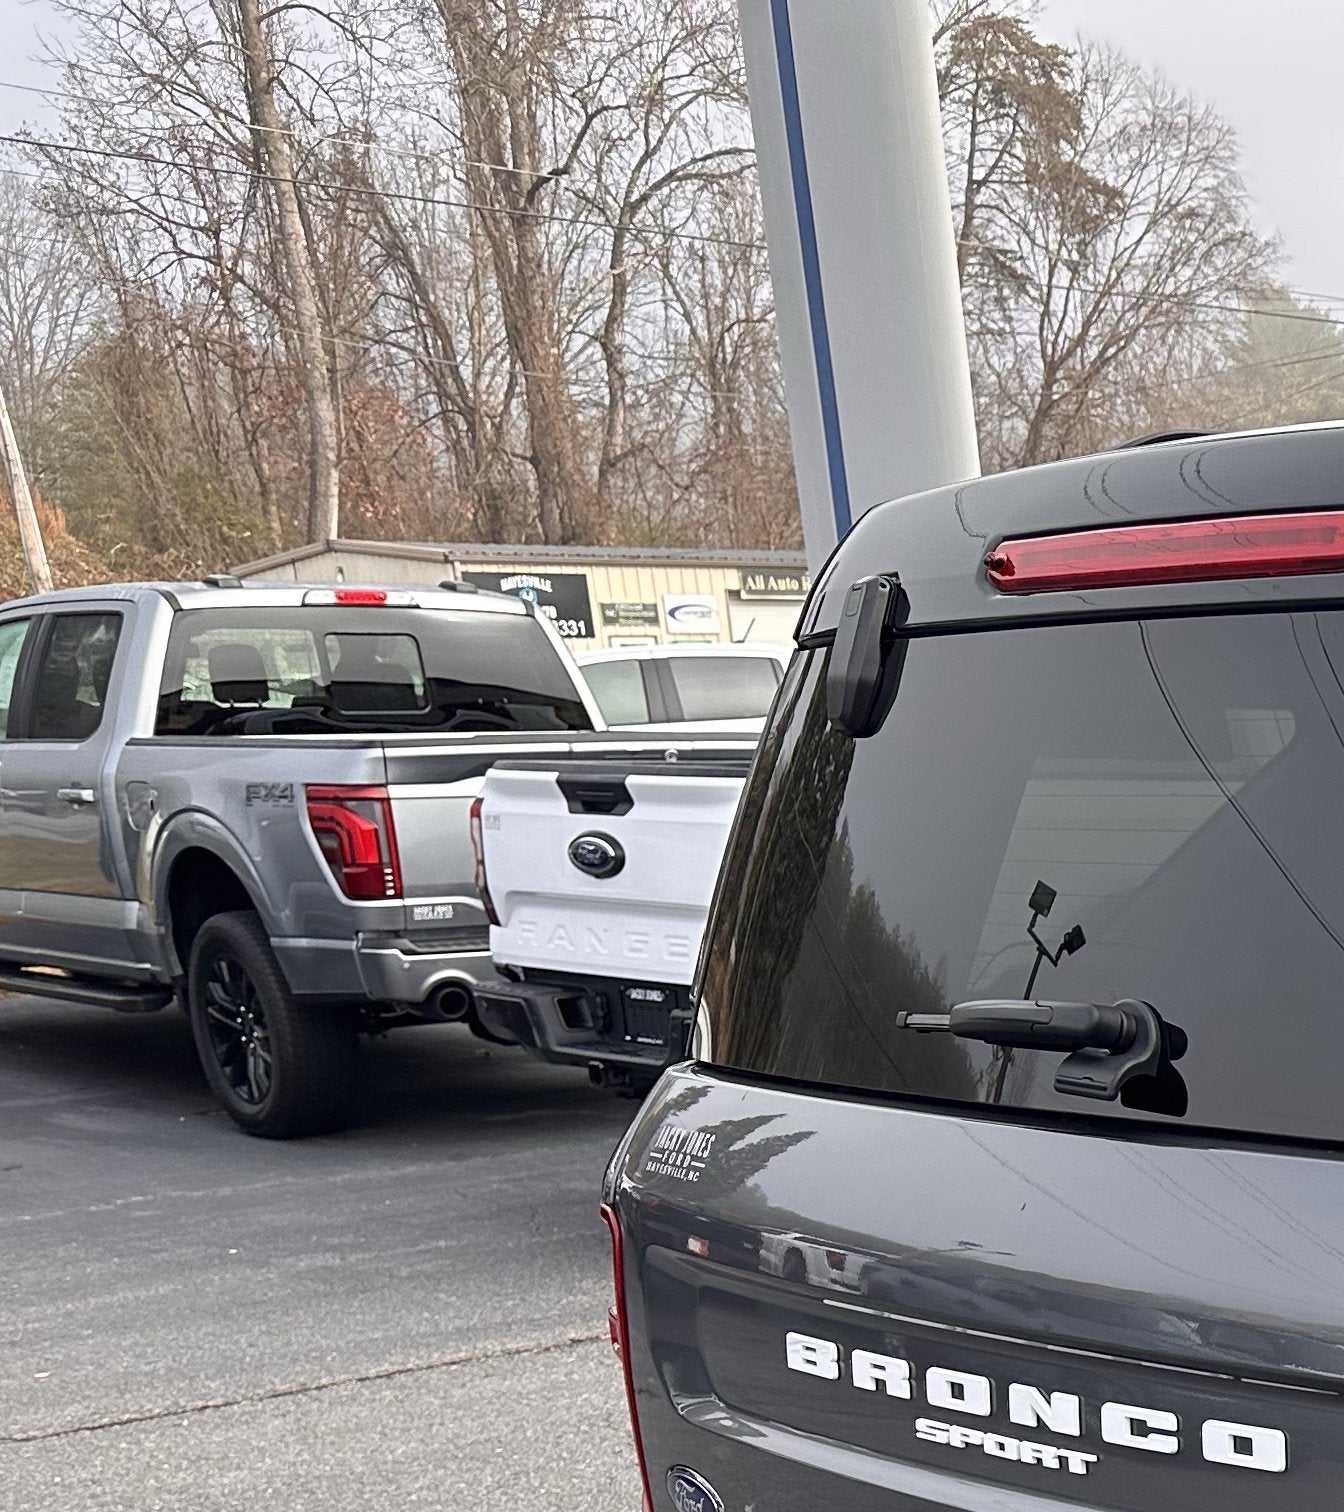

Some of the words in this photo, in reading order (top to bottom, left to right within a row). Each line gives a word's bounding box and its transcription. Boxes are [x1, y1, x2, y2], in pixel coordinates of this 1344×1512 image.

[746, 575, 765, 591] All
[767, 575, 800, 591] Auto
[246, 782, 294, 803] FX4
[517, 920, 691, 962] RANGE
[654, 1126, 686, 1151] JACKY
[681, 1130, 716, 1158] JONES
[661, 1150, 691, 1168] FORD
[785, 1331, 1289, 1473] BRONCO
[914, 1416, 1099, 1476] SPORT
